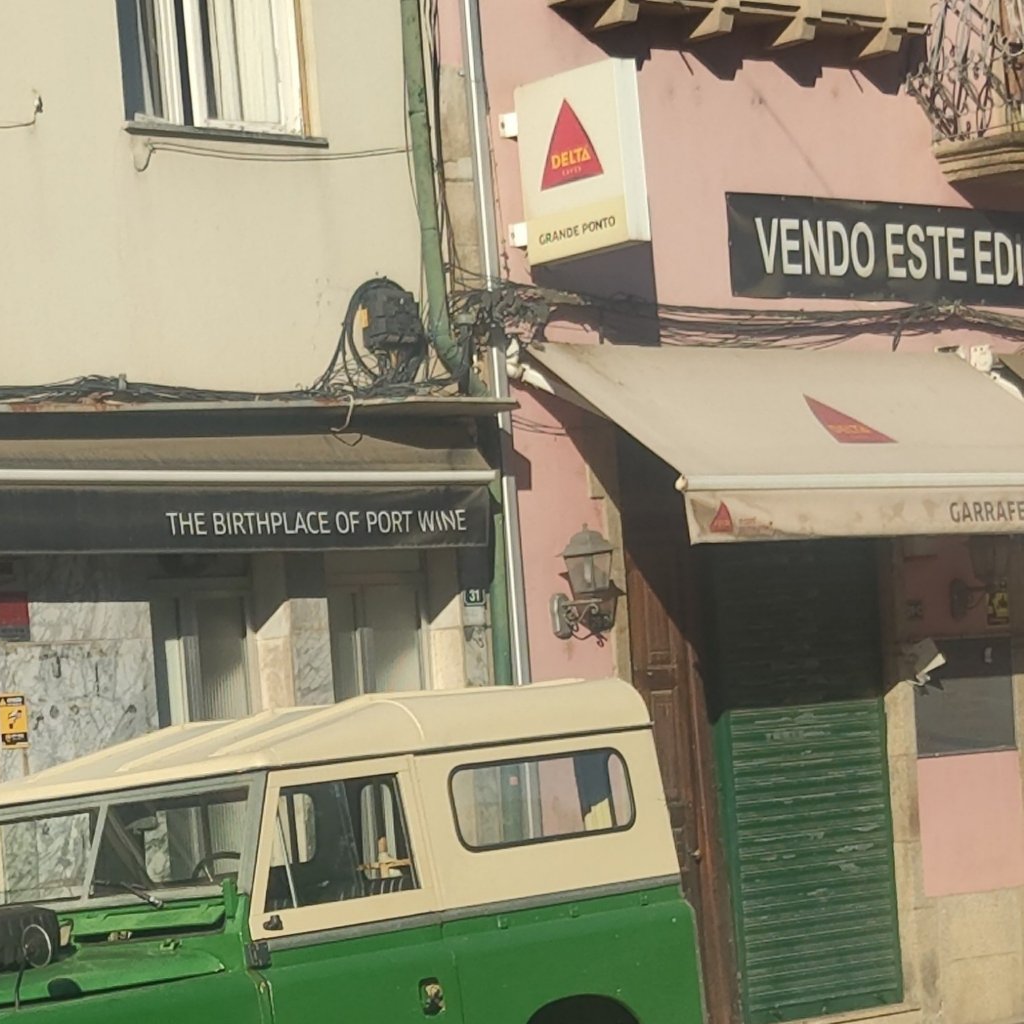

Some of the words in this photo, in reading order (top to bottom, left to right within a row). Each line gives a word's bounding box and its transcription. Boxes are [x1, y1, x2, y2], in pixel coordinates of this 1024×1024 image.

[551, 147, 591, 170] DELTA
[538, 225, 580, 246] GRANDE
[582, 215, 616, 235] PONTO
[754, 217, 875, 279] VENDO
[885, 223, 967, 281] ESTE
[166, 512, 207, 536] THE
[212, 511, 331, 535] BIRTHPLACE
[335, 511, 360, 534] OF
[366, 510, 412, 534] PORT
[418, 509, 467, 532] WINE
[949, 500, 1024, 523] GARRAFE
[468, 588, 480, 602] 31
